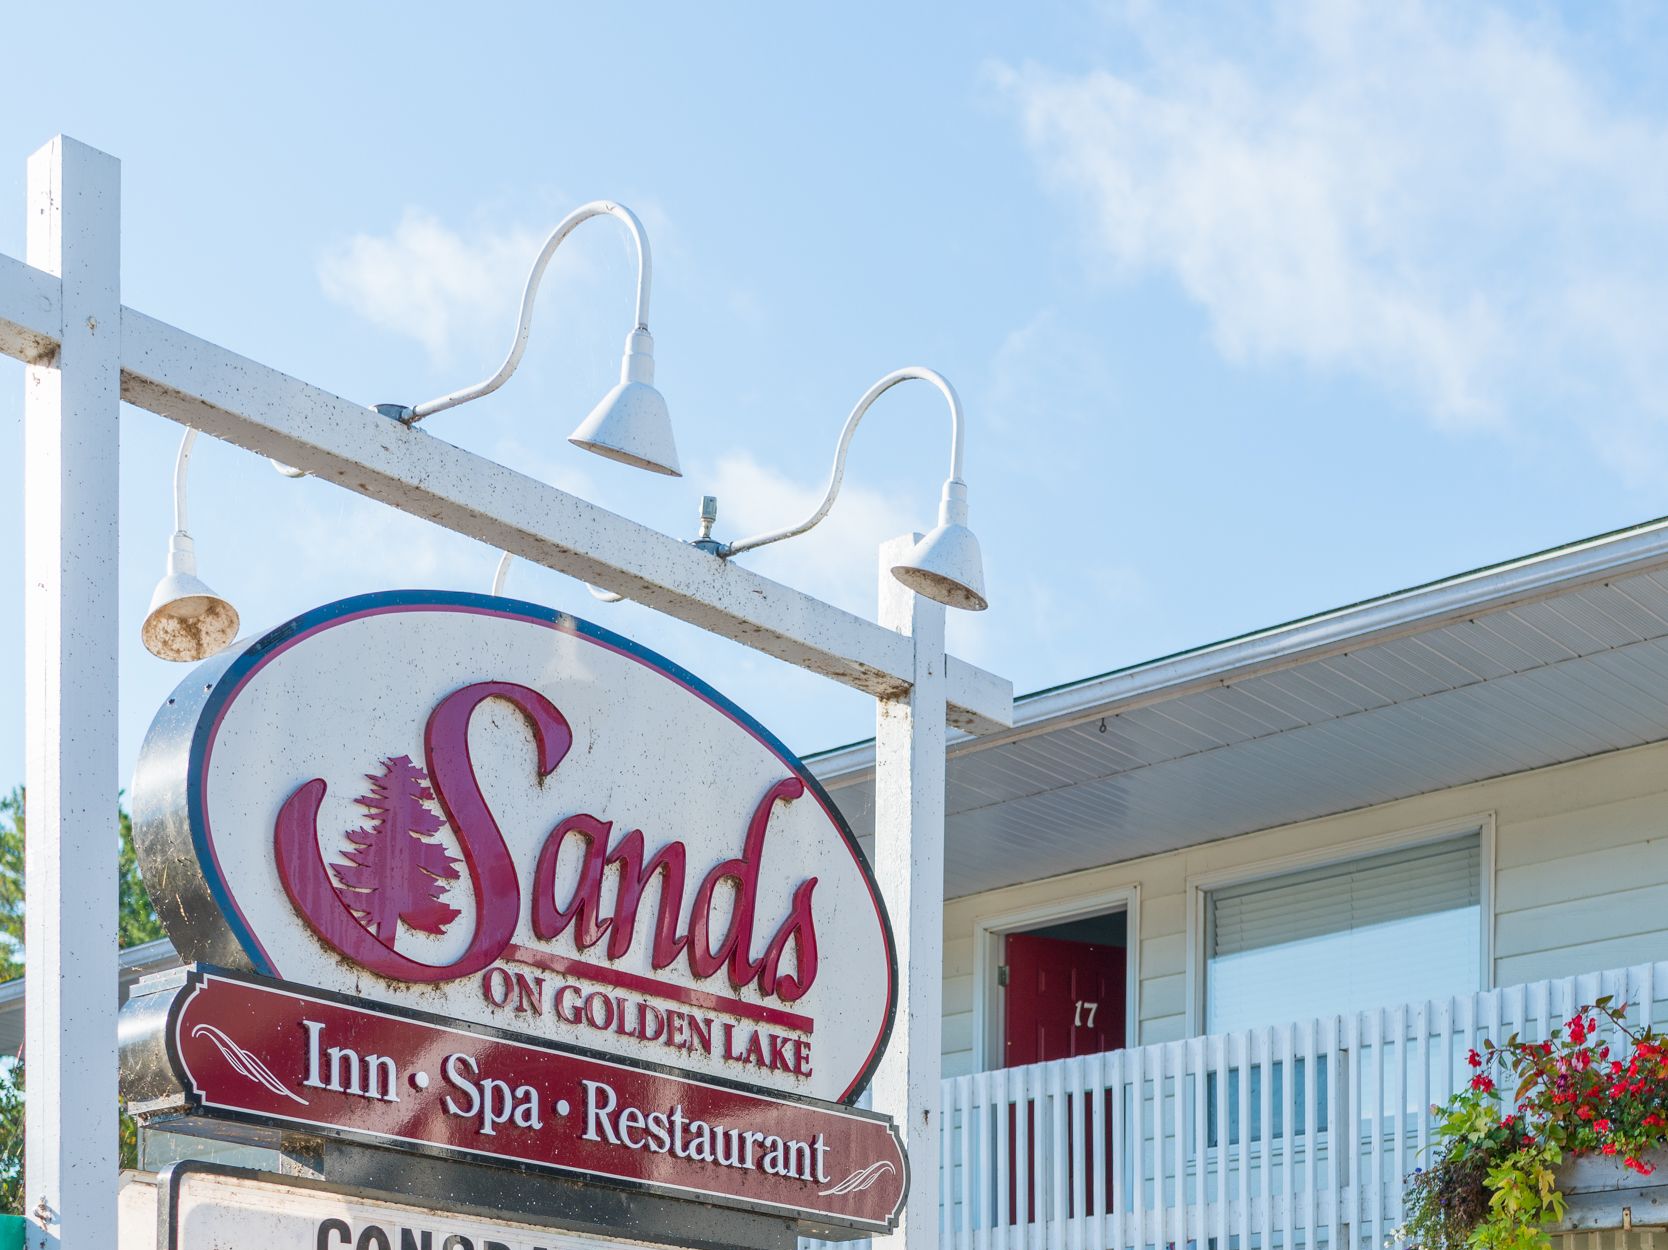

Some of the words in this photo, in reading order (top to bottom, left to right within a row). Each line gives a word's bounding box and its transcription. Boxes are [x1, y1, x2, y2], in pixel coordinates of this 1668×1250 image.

[274, 681, 818, 1000] Sands
[482, 965, 543, 1016] ON
[555, 985, 714, 1056] GOLDEN
[722, 1023, 813, 1079] LAKE
[1074, 1000, 1098, 1027] 17
[302, 1020, 398, 1102] Inn
[442, 1053, 542, 1136] Spa
[582, 1080, 830, 1185] Restaurant
